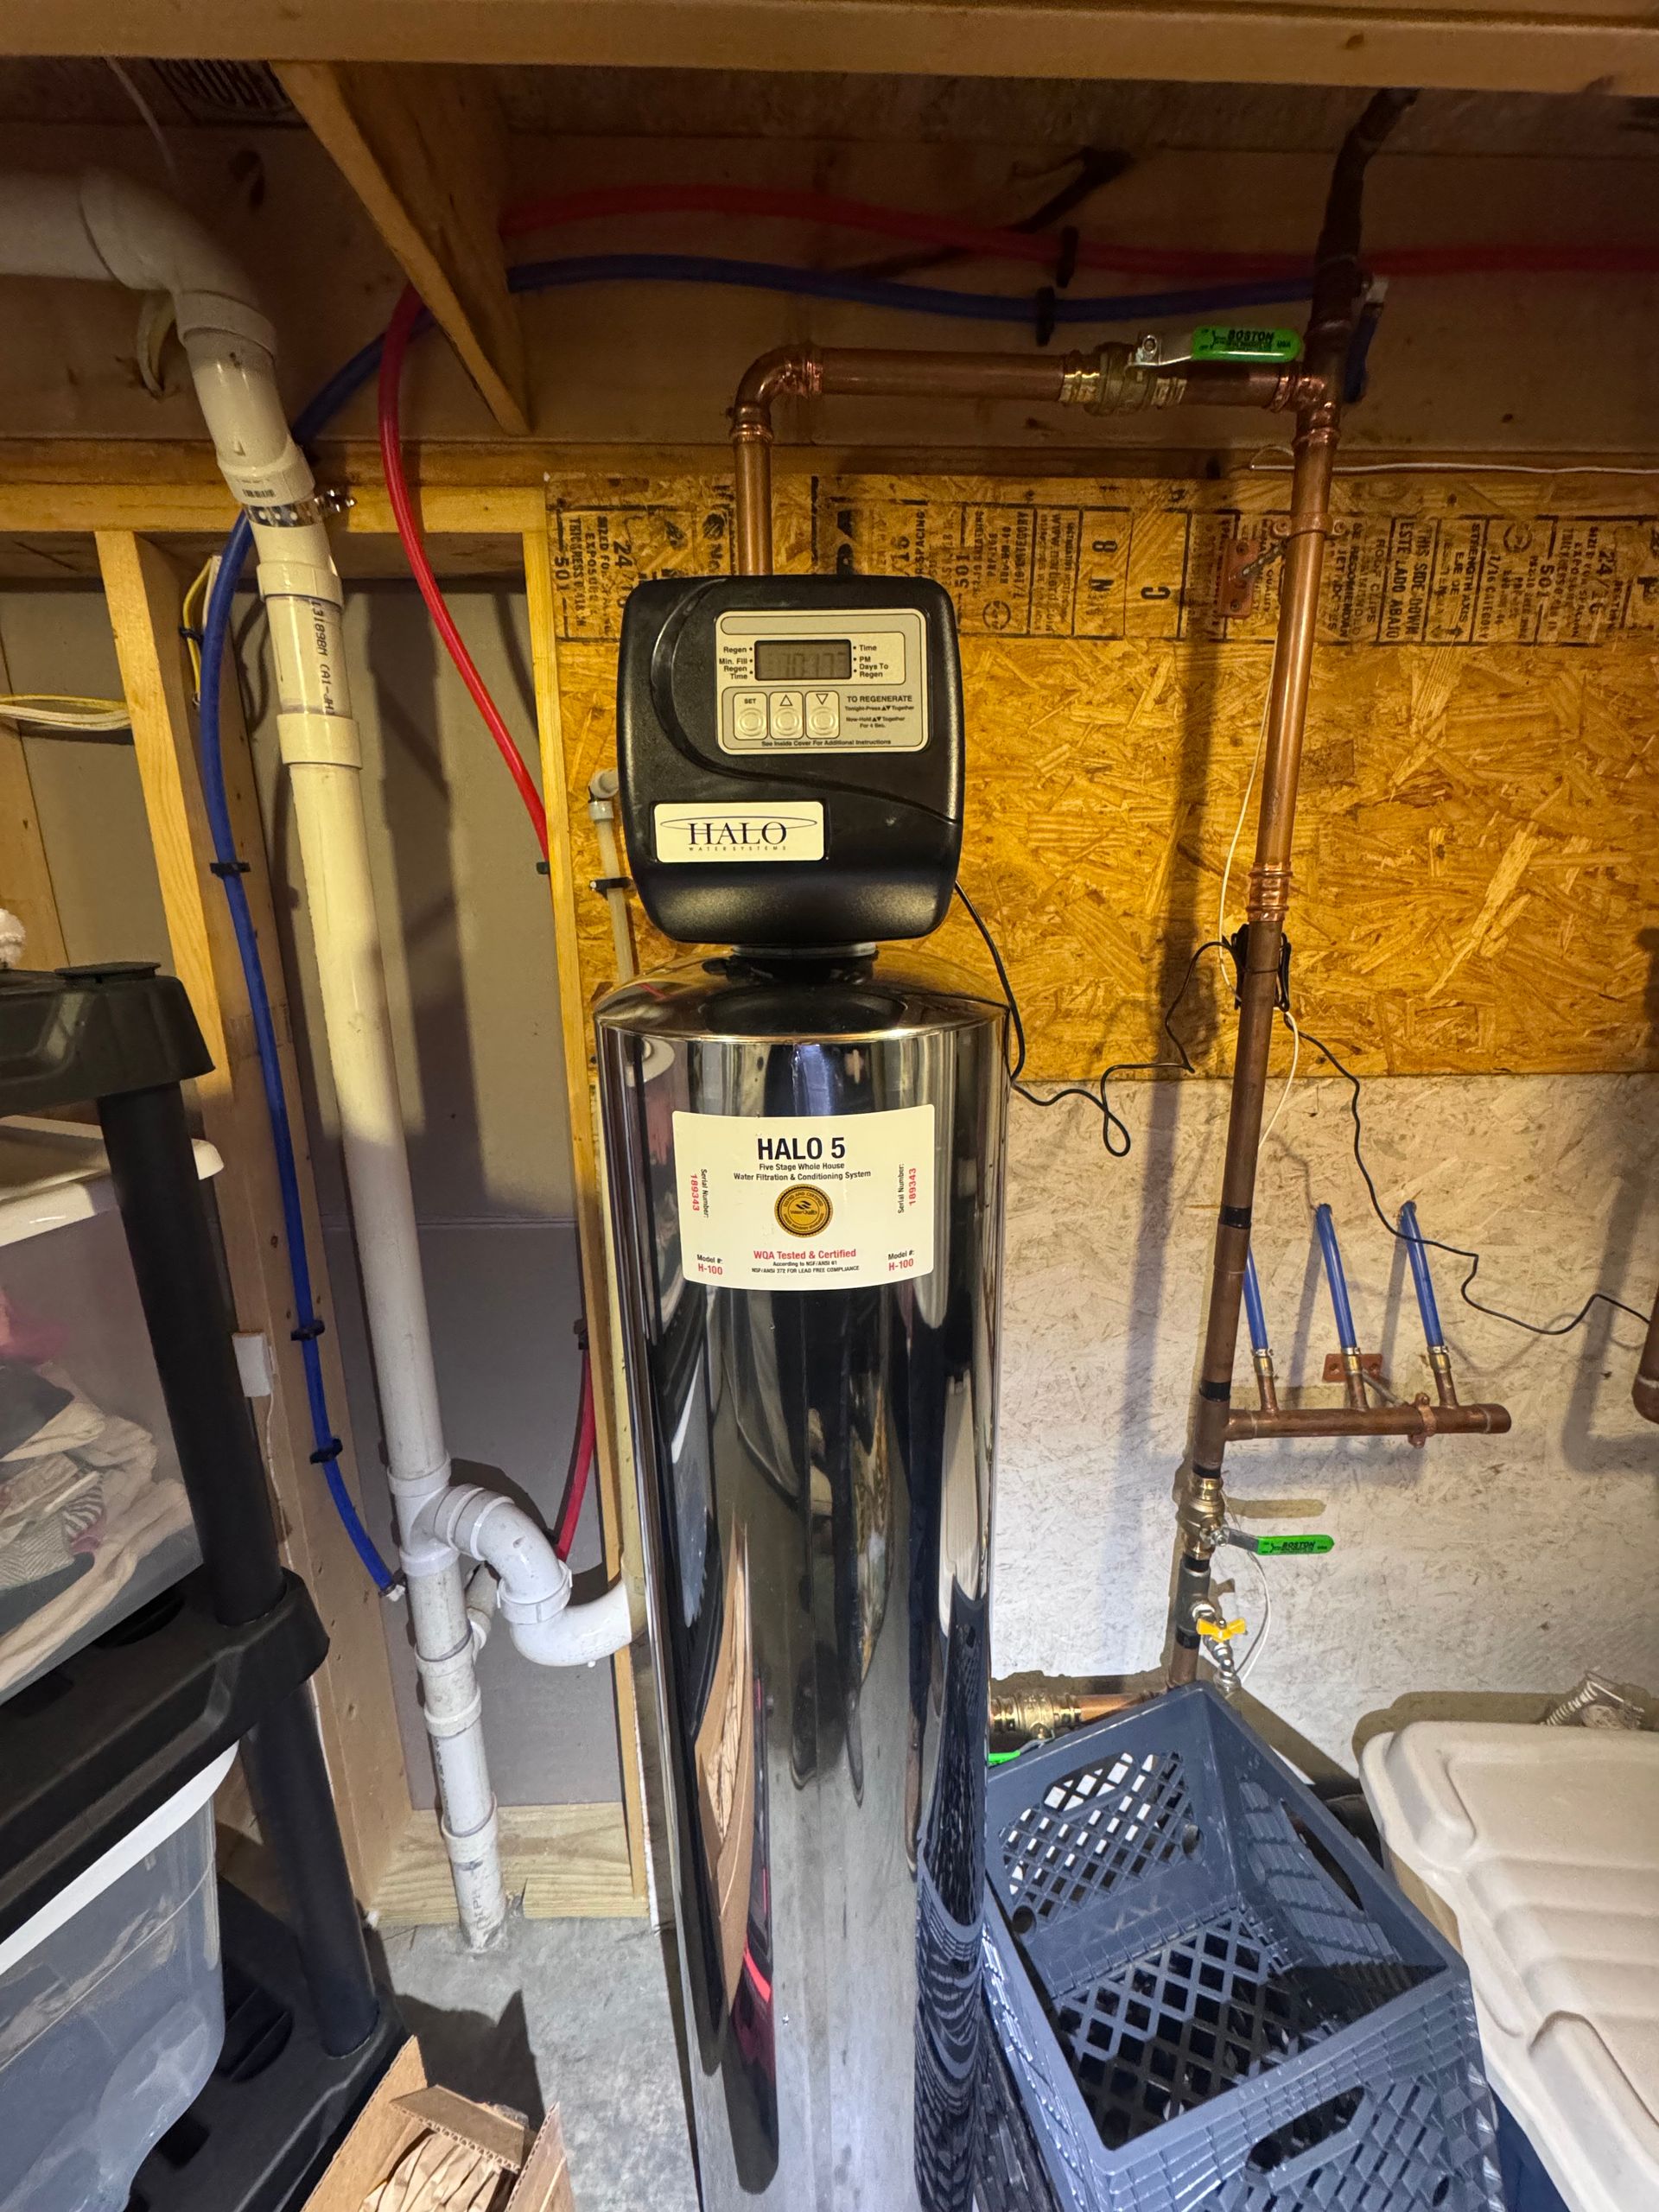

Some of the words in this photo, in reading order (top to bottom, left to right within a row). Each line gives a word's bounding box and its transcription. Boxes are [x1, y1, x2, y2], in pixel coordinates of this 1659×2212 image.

[1228, 329, 1274, 343] BOSTON
[1091, 540, 1118, 553] 8
[1397, 522, 1415, 555] ESTE
[1415, 524, 1433, 557] THIS
[1464, 523, 1481, 592] STRENGTH
[554, 556, 570, 591] 501
[955, 553, 969, 589] 501
[1392, 560, 1407, 594] LADO
[1411, 563, 1428, 592] SIDE
[1537, 564, 1554, 598] 501
[1141, 587, 1171, 600] C
[1386, 599, 1402, 639] ABAJO
[1405, 598, 1423, 636] DOWN
[1459, 594, 1471, 623] AXIS
[687, 821, 787, 845] HALO
[758, 1137, 823, 1160] HALO
[831, 1137, 845, 1159] 5
[776, 1163, 796, 1172] Stage
[798, 1173, 842, 1181] Conditioning
[845, 1170, 871, 1179] System
[690, 1173, 700, 1211] 189343
[696, 1254, 715, 1263] Model
[753, 1250, 775, 1260] WQA
[778, 1250, 805, 1259] Tested
[809, 1250, 816, 1259] &
[818, 1249, 856, 1259] Certified
[888, 1250, 907, 1260] Model
[888, 1258, 914, 1271] H-100
[697, 1263, 723, 1275] H-100
